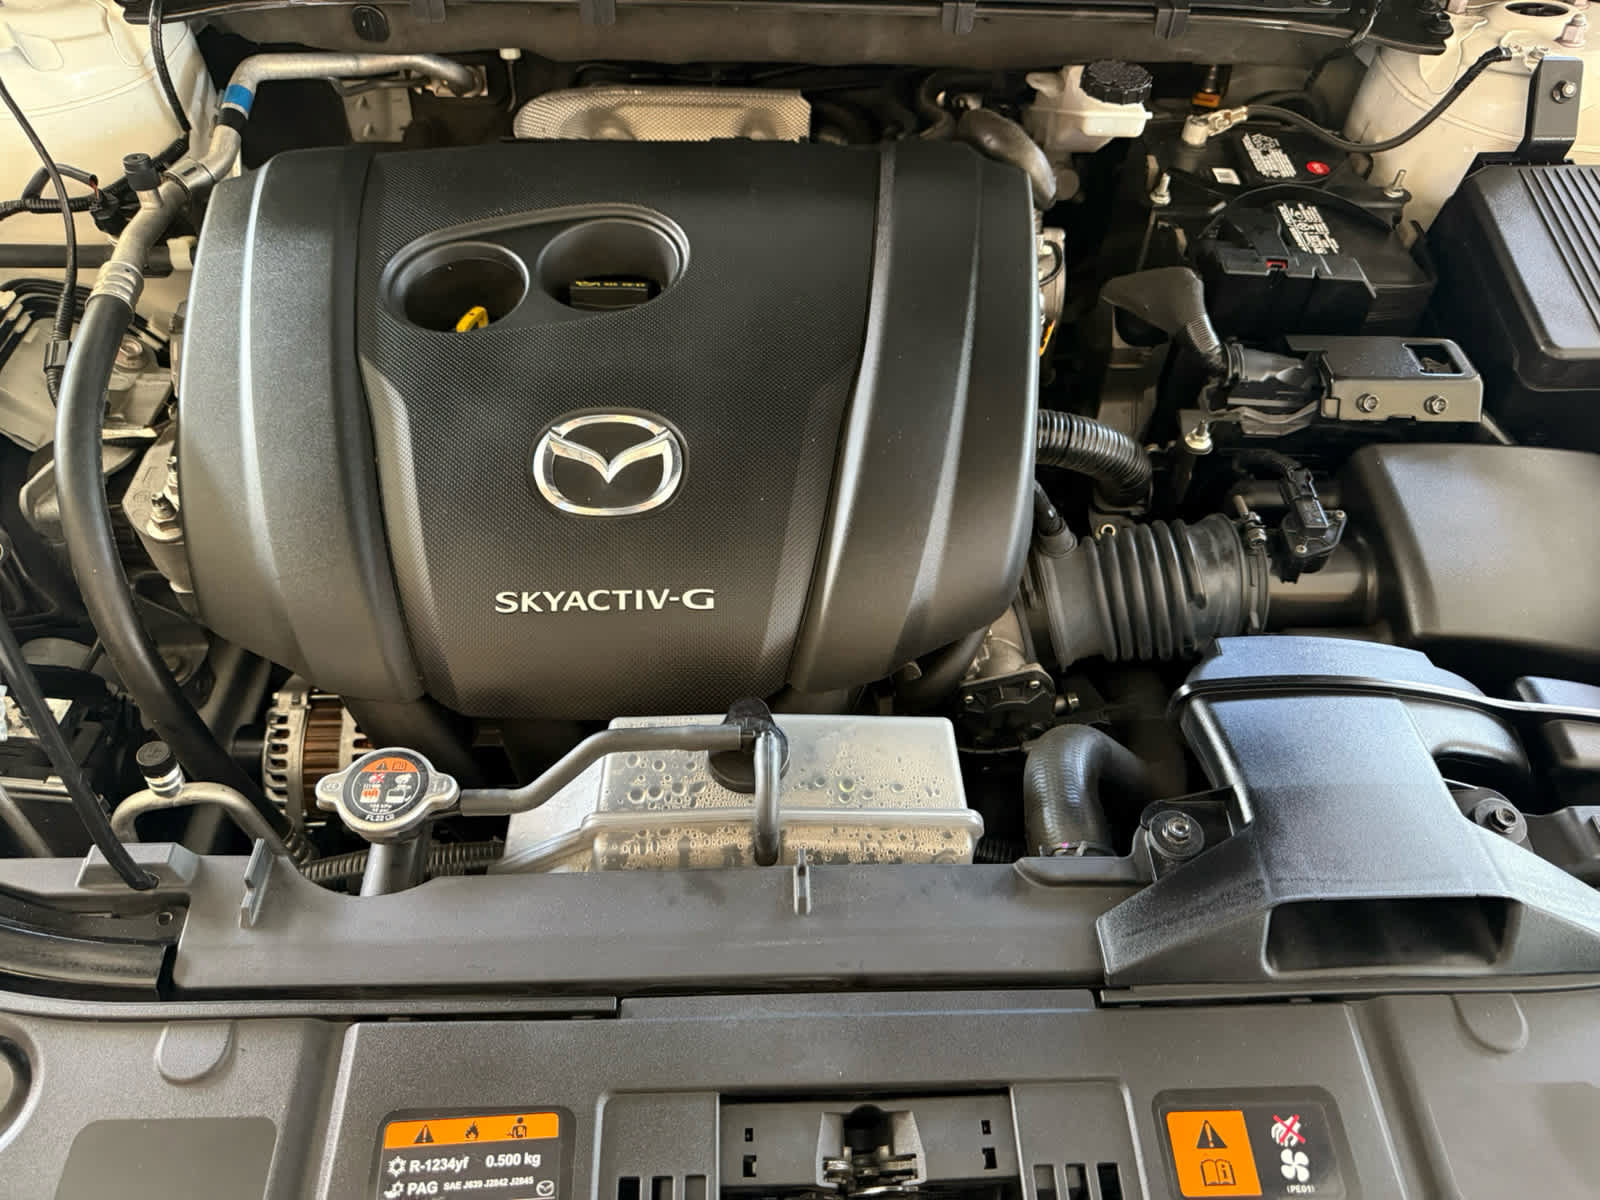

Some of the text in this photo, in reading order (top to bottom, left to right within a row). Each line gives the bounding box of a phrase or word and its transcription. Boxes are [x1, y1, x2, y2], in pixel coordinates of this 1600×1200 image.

[495, 588, 715, 613] SKYACTIV-G
[409, 1152, 541, 1173] R-1234yf 0.500 kg
[407, 1180, 439, 1196] PAG
[443, 1181, 462, 1191] SAE
